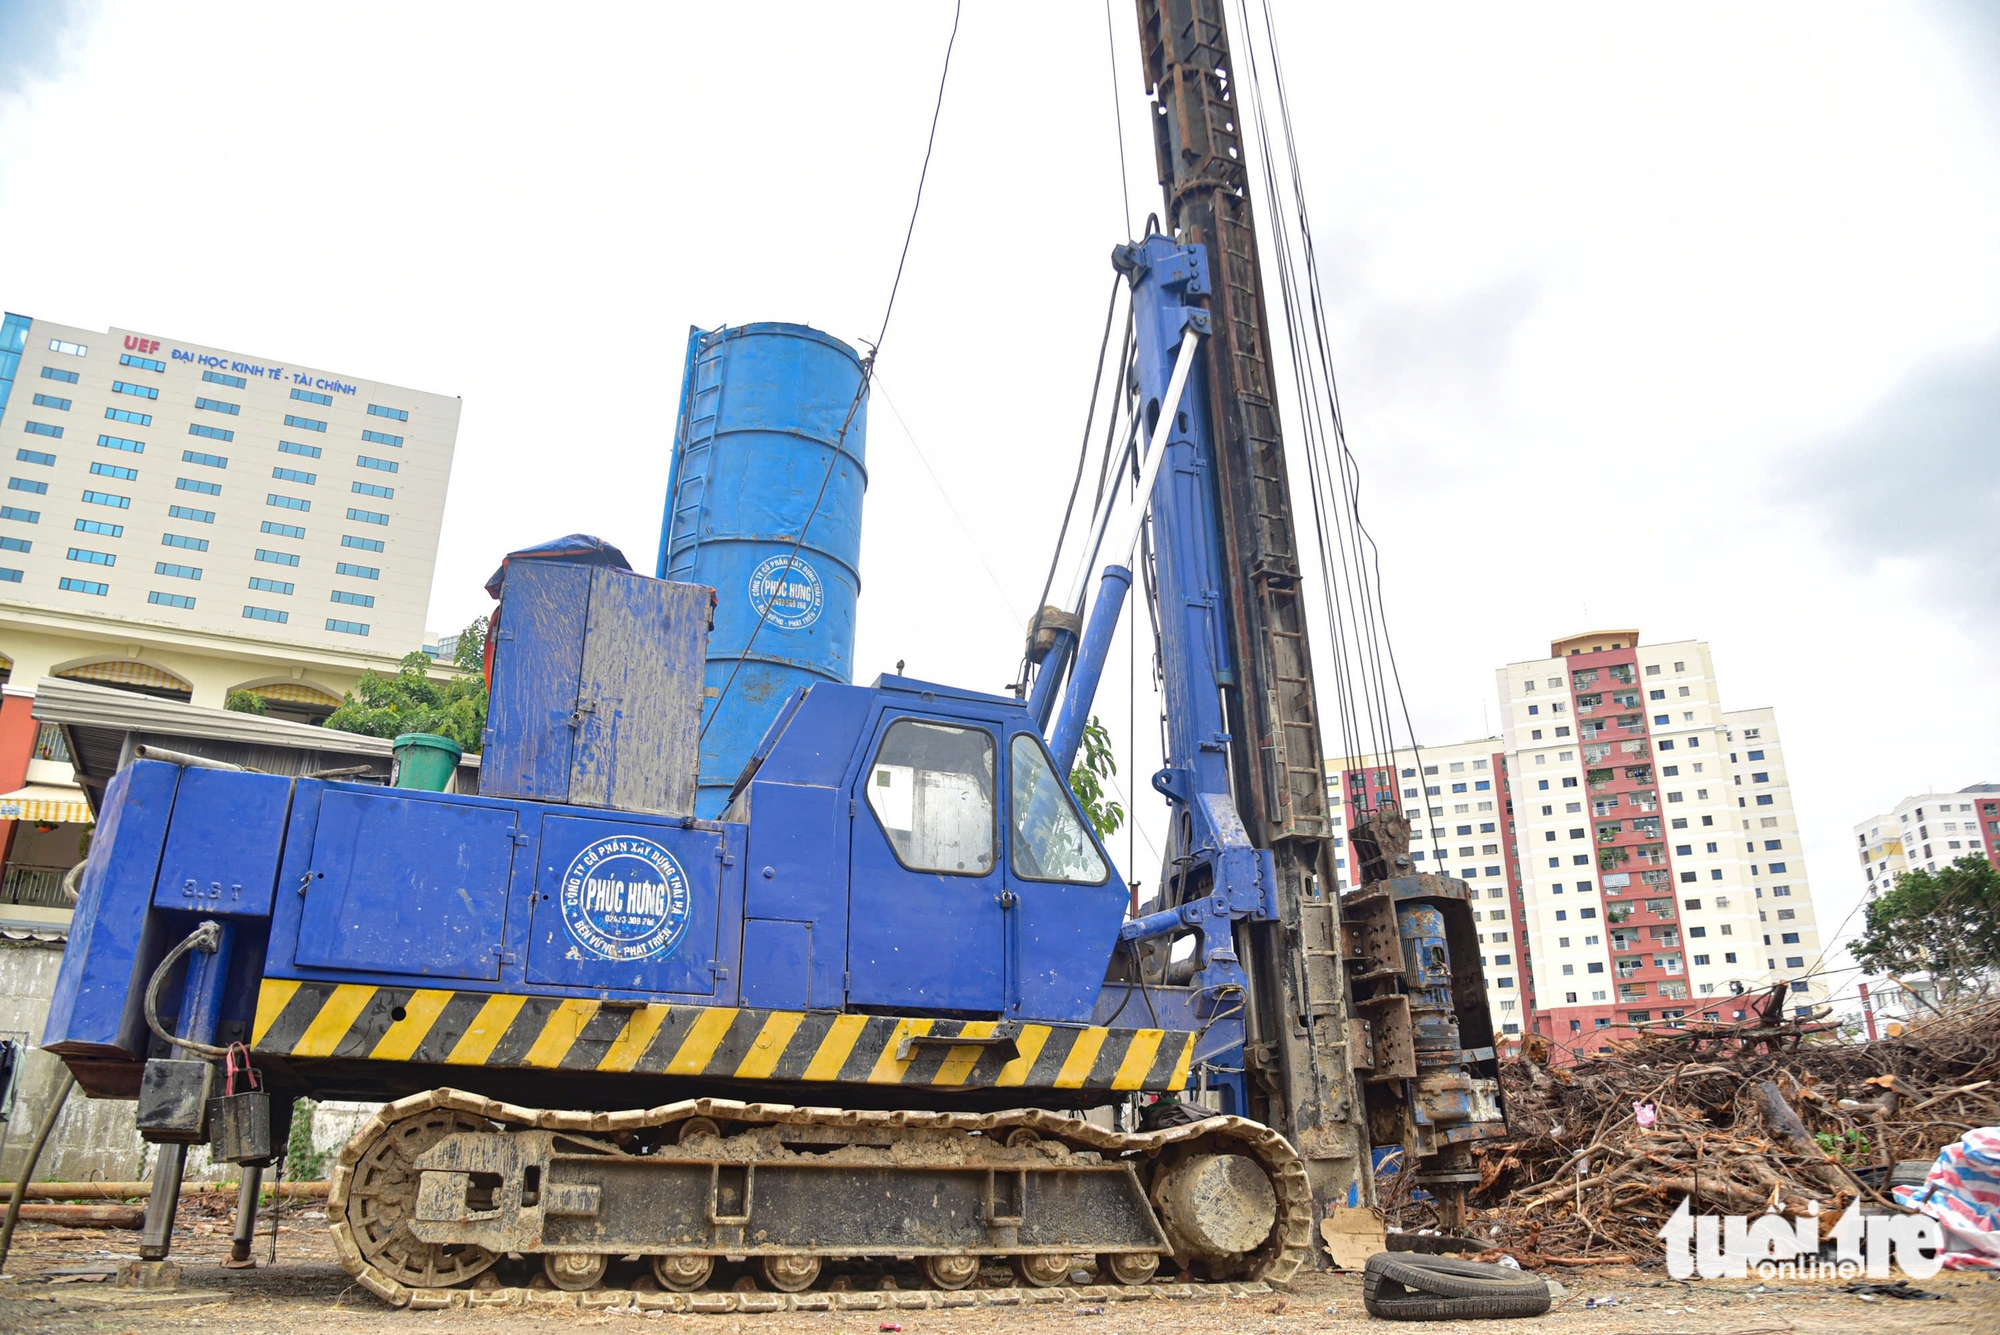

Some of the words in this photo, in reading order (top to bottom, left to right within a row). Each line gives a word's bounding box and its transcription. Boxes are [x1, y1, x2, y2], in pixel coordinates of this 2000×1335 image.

[124, 335, 160, 354] UEF
[171, 348, 194, 364] ĐẠI
[197, 354, 228, 370] HỌC
[231, 361, 264, 377] KINH
[268, 367, 284, 381] TẾ
[293, 372, 312, 387] TÀI
[315, 378, 357, 396] CHÍNH
[765, 578, 787, 597] PHÚC
[790, 583, 811, 601] HƯNG
[565, 878, 580, 906] CÔNG
[574, 864, 586, 876] TY
[583, 848, 599, 866] CỔ
[598, 840, 628, 856] PHẦN
[631, 843, 651, 856] XÂY
[651, 851, 676, 875] DỰNG
[671, 876, 684, 899] THÁI
[586, 873, 625, 913] PHÚC
[627, 880, 665, 916] HƯNG
[573, 920, 592, 940] BỀN
[590, 935, 616, 955] VỮNG
[623, 943, 648, 956] PHÁT
[647, 926, 673, 950] TRIỂN
